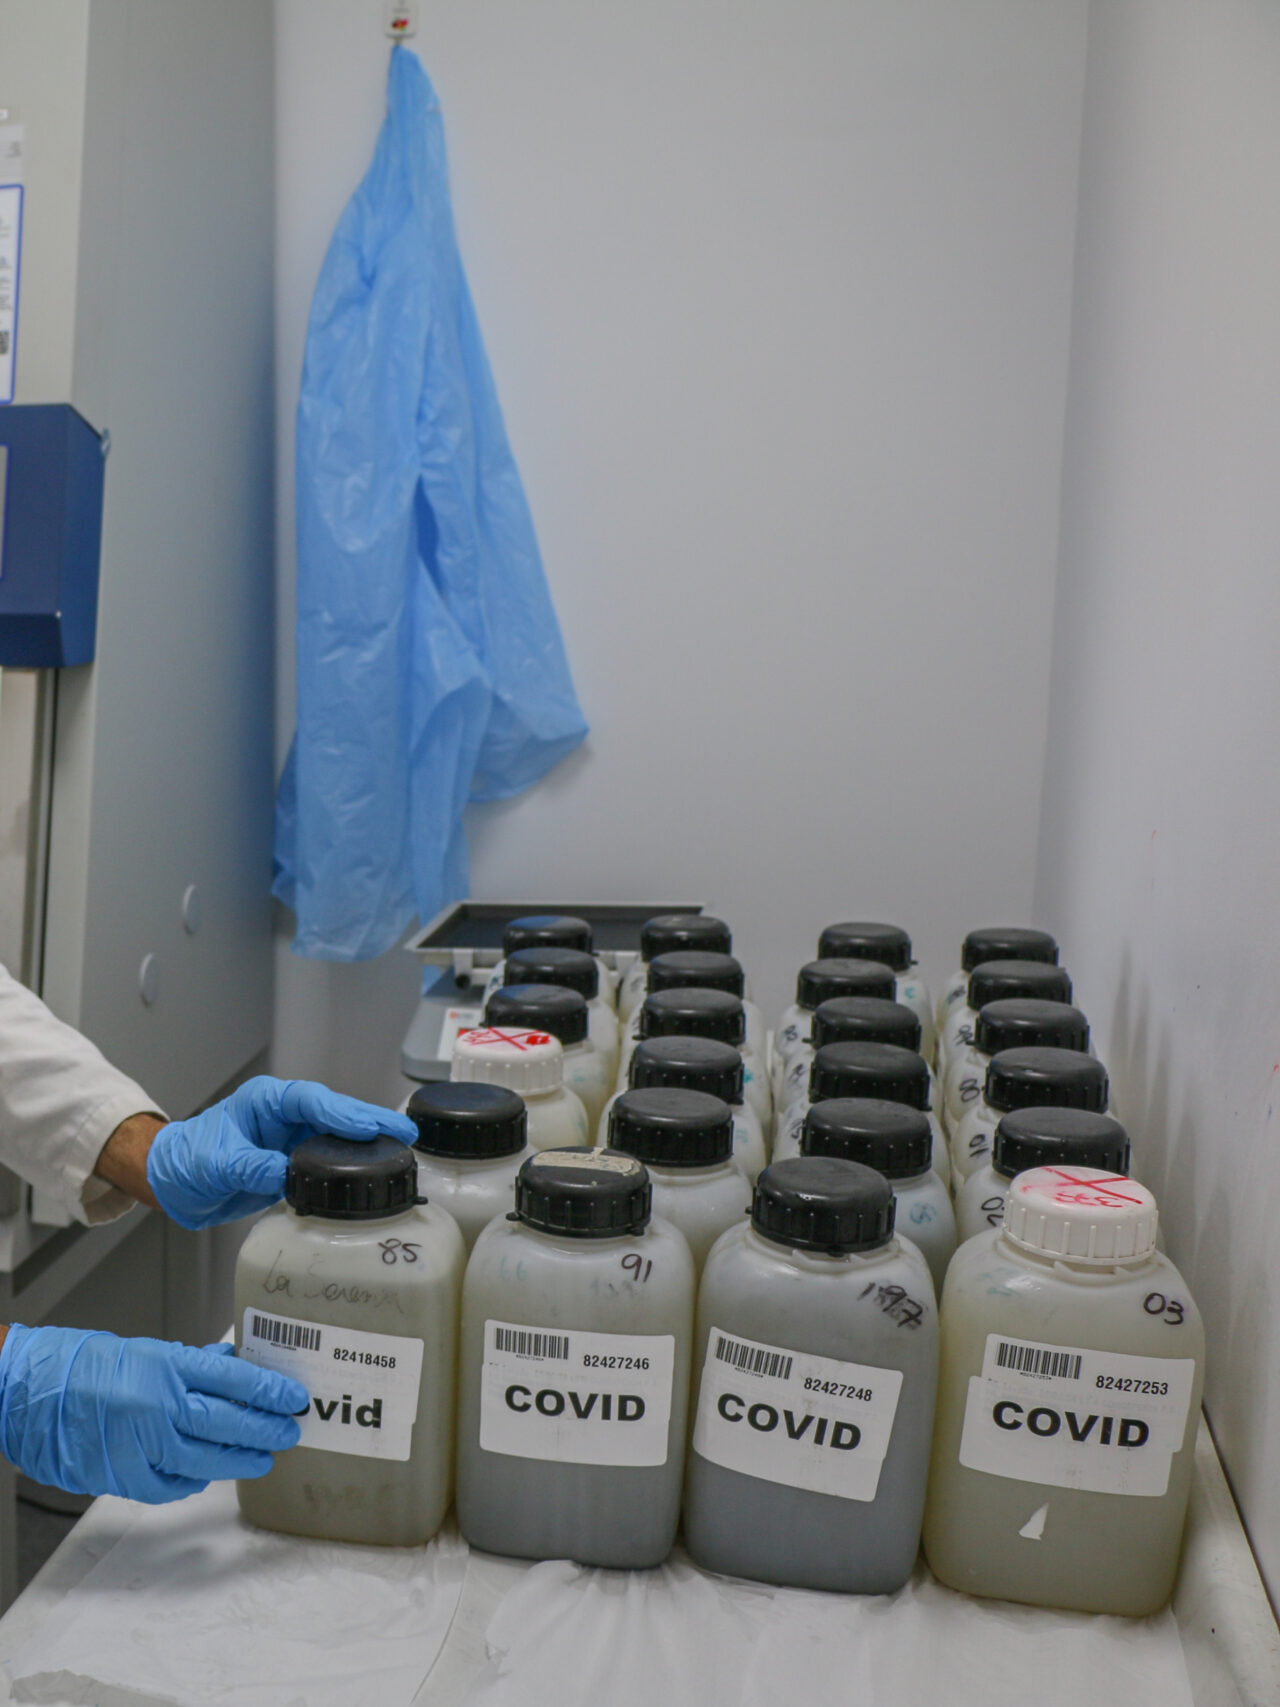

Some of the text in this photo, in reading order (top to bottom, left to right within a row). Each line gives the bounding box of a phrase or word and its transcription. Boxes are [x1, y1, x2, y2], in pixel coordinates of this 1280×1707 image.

[378, 1238, 421, 1265] 85
[621, 1253, 652, 1283] 91
[1143, 1292, 1185, 1326] 03
[333, 1348, 397, 1369] 82418458
[583, 1354, 650, 1370] 82427246
[803, 1377, 873, 1402] 82427248
[1095, 1374, 1169, 1396] 82427253
[293, 1394, 383, 1429] vid
[505, 1385, 646, 1422] COVID
[717, 1393, 862, 1451] COVID
[993, 1401, 1150, 1448] COVID
